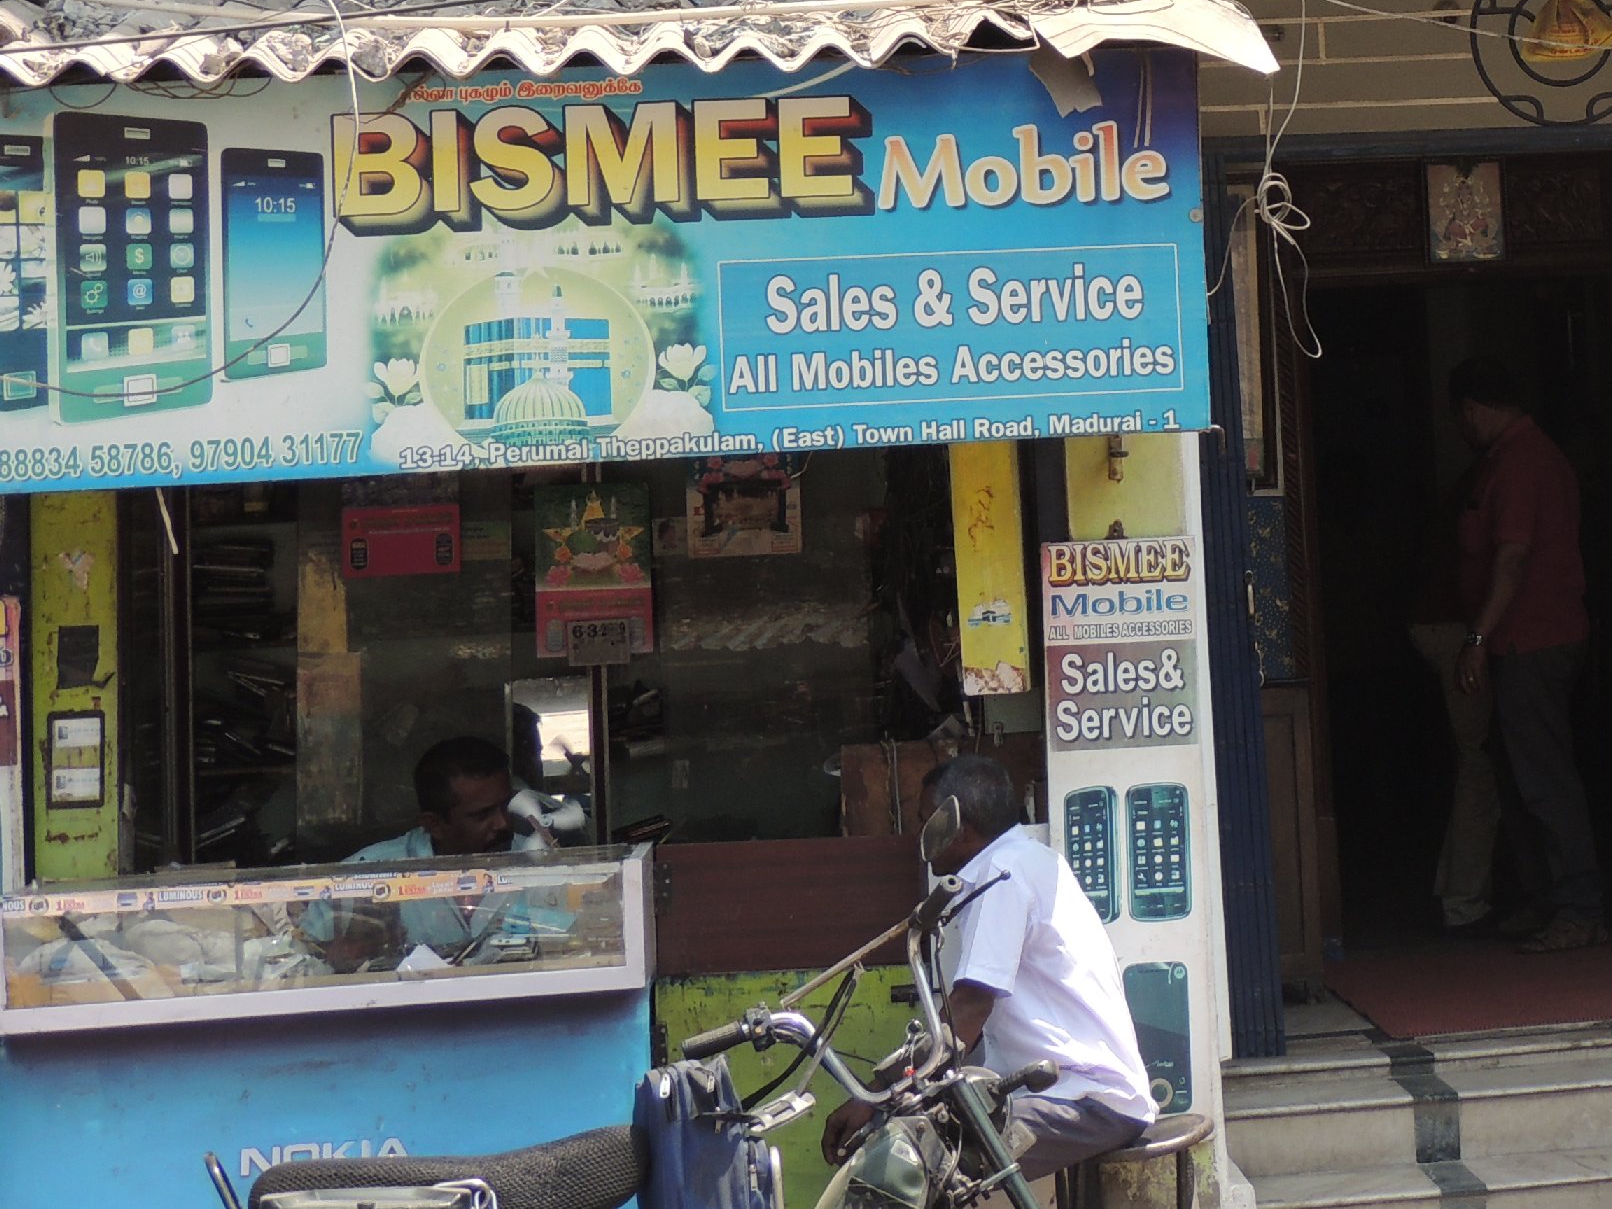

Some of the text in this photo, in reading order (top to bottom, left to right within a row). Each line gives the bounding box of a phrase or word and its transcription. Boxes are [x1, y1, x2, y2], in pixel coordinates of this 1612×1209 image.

[330, 96, 1171, 237] BISMEE Mobile
[254, 196, 296, 214] 10:15
[765, 262, 1145, 335] Sales & Service
[728, 336, 1177, 396] All Mobiles Accessories
[0, 431, 363, 483] 88834 58786, 97904 31177
[400, 446, 479, 471] 13-14,
[488, 437, 591, 466] Perumal
[597, 431, 764, 462] Theppakulam,
[770, 424, 846, 454] (East)
[854, 423, 916, 445] Town
[919, 418, 966, 441] Hall
[974, 416, 1041, 440] Road,
[1047, 411, 1145, 436] Madurai
[1161, 409, 1180, 431] 1
[1048, 538, 1192, 587] BISMEE
[1050, 588, 1190, 619] Mobile
[1048, 619, 1193, 640] ALL MOBILES ACCESSORIES
[1056, 696, 1193, 742] Service
[240, 1137, 409, 1178] NOKIA
